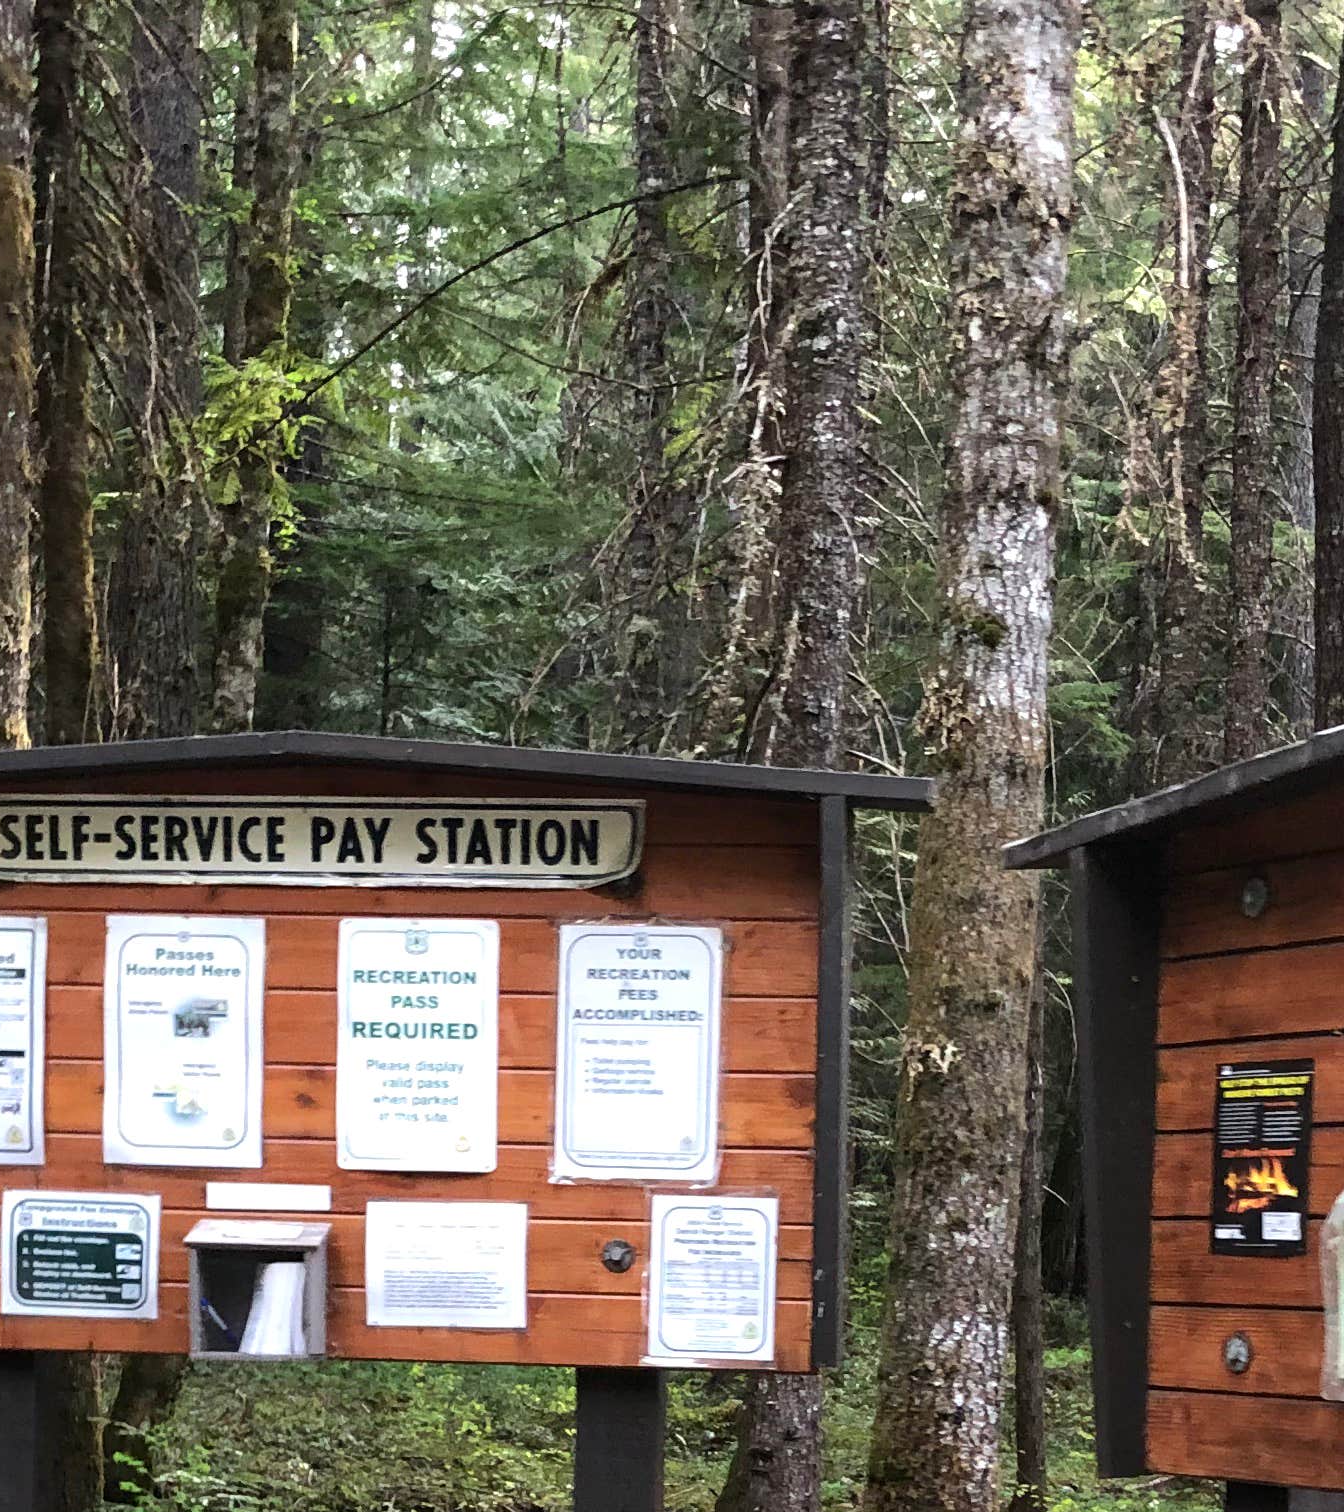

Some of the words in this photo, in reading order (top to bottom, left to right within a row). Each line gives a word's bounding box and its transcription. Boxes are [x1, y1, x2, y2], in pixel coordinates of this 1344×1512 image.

[0, 813, 286, 863] SELF-SERVICE
[311, 816, 392, 864] PAY
[416, 818, 600, 867] STATION
[155, 948, 214, 961] Passes
[616, 949, 662, 960] YOUR
[126, 964, 195, 976] Honored
[202, 965, 241, 977] Here
[353, 970, 477, 984] RECREATION
[587, 969, 690, 981] RECREATION
[618, 989, 658, 1000] FEES
[391, 996, 439, 1009] PASS
[352, 1022, 478, 1040] REQUIRED
[367, 1059, 410, 1071] Please
[416, 1060, 464, 1074] display
[417, 1079, 449, 1091] pass
[412, 1096, 459, 1107] parked
